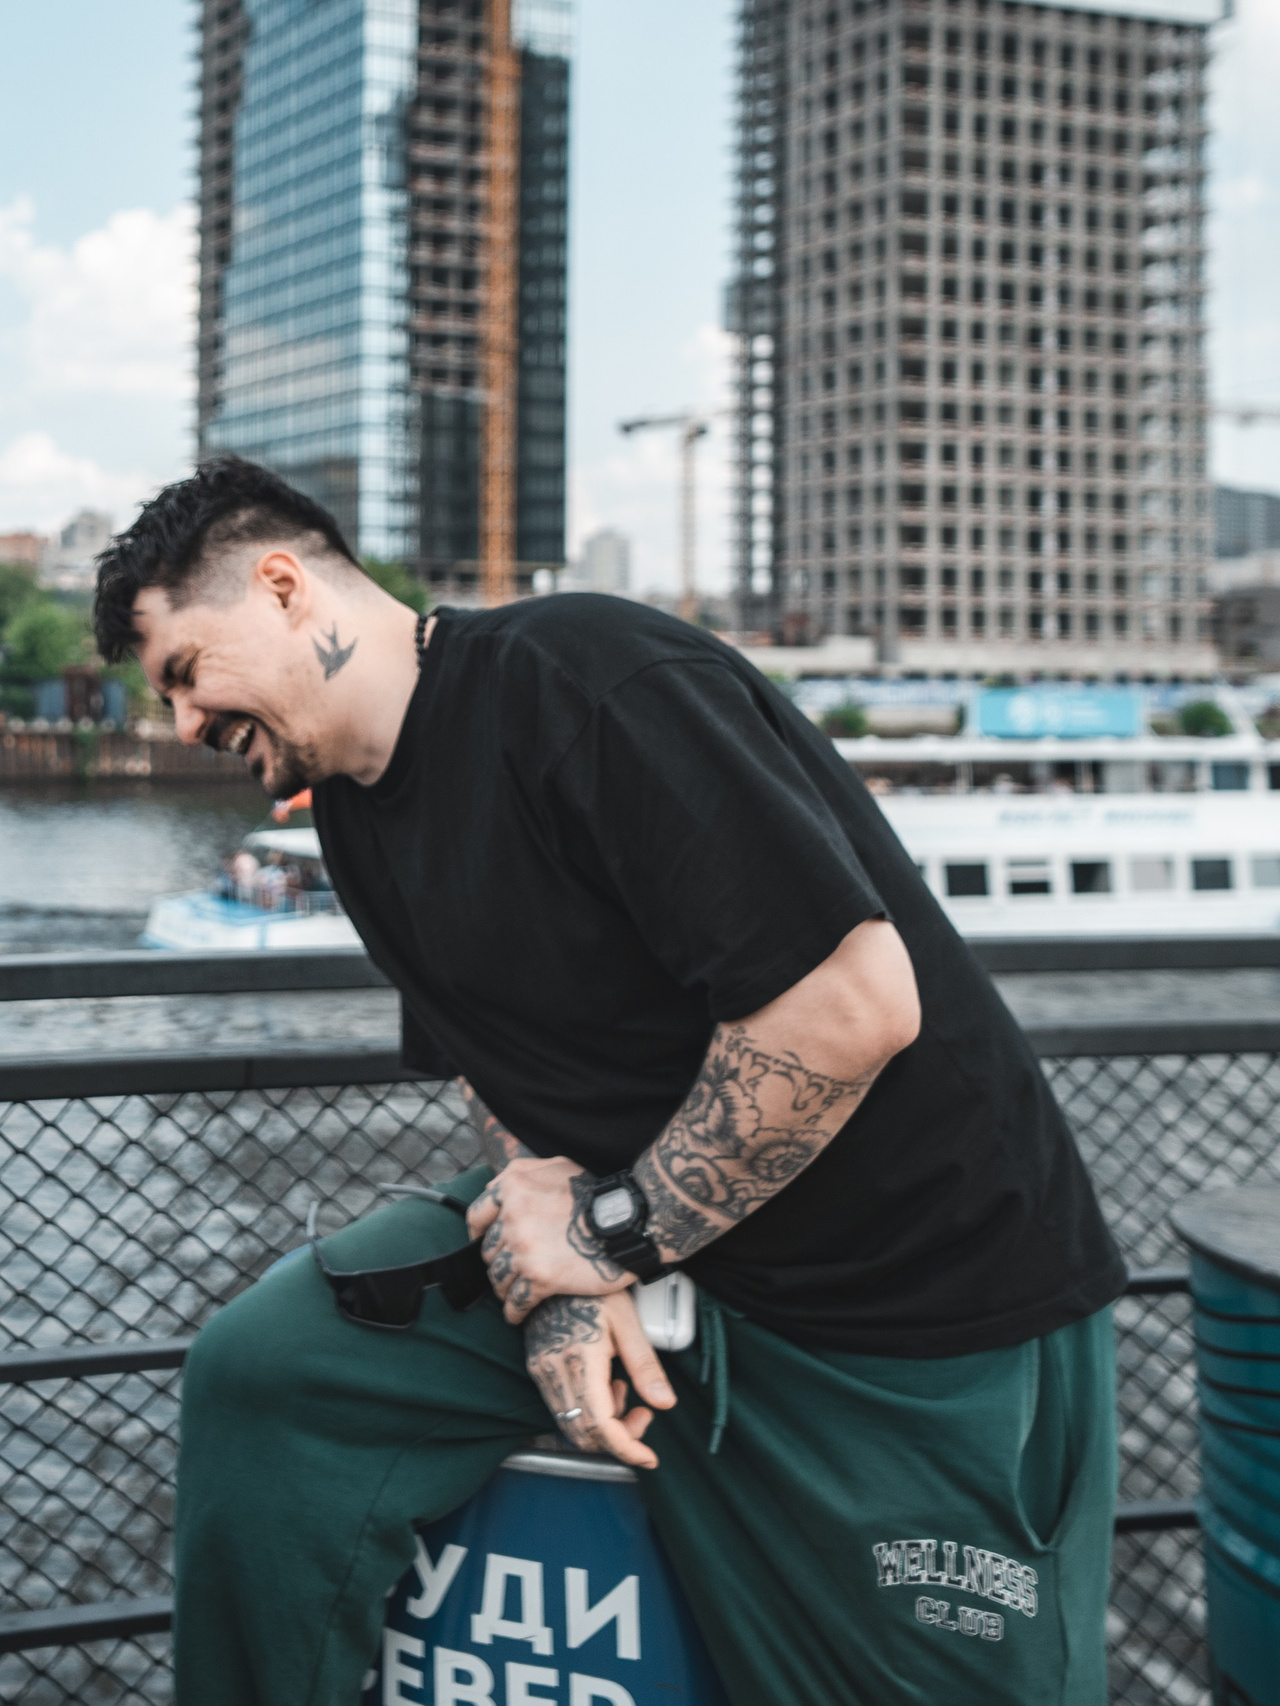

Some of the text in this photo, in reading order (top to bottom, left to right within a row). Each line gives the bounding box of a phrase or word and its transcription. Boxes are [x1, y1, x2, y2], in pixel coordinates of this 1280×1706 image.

[386, 1533, 641, 1661] УДИ
[872, 1538, 1039, 1618] WELLNESS
[915, 1595, 1005, 1642] CLUB
[362, 1626, 639, 1706] ЕВЕ
